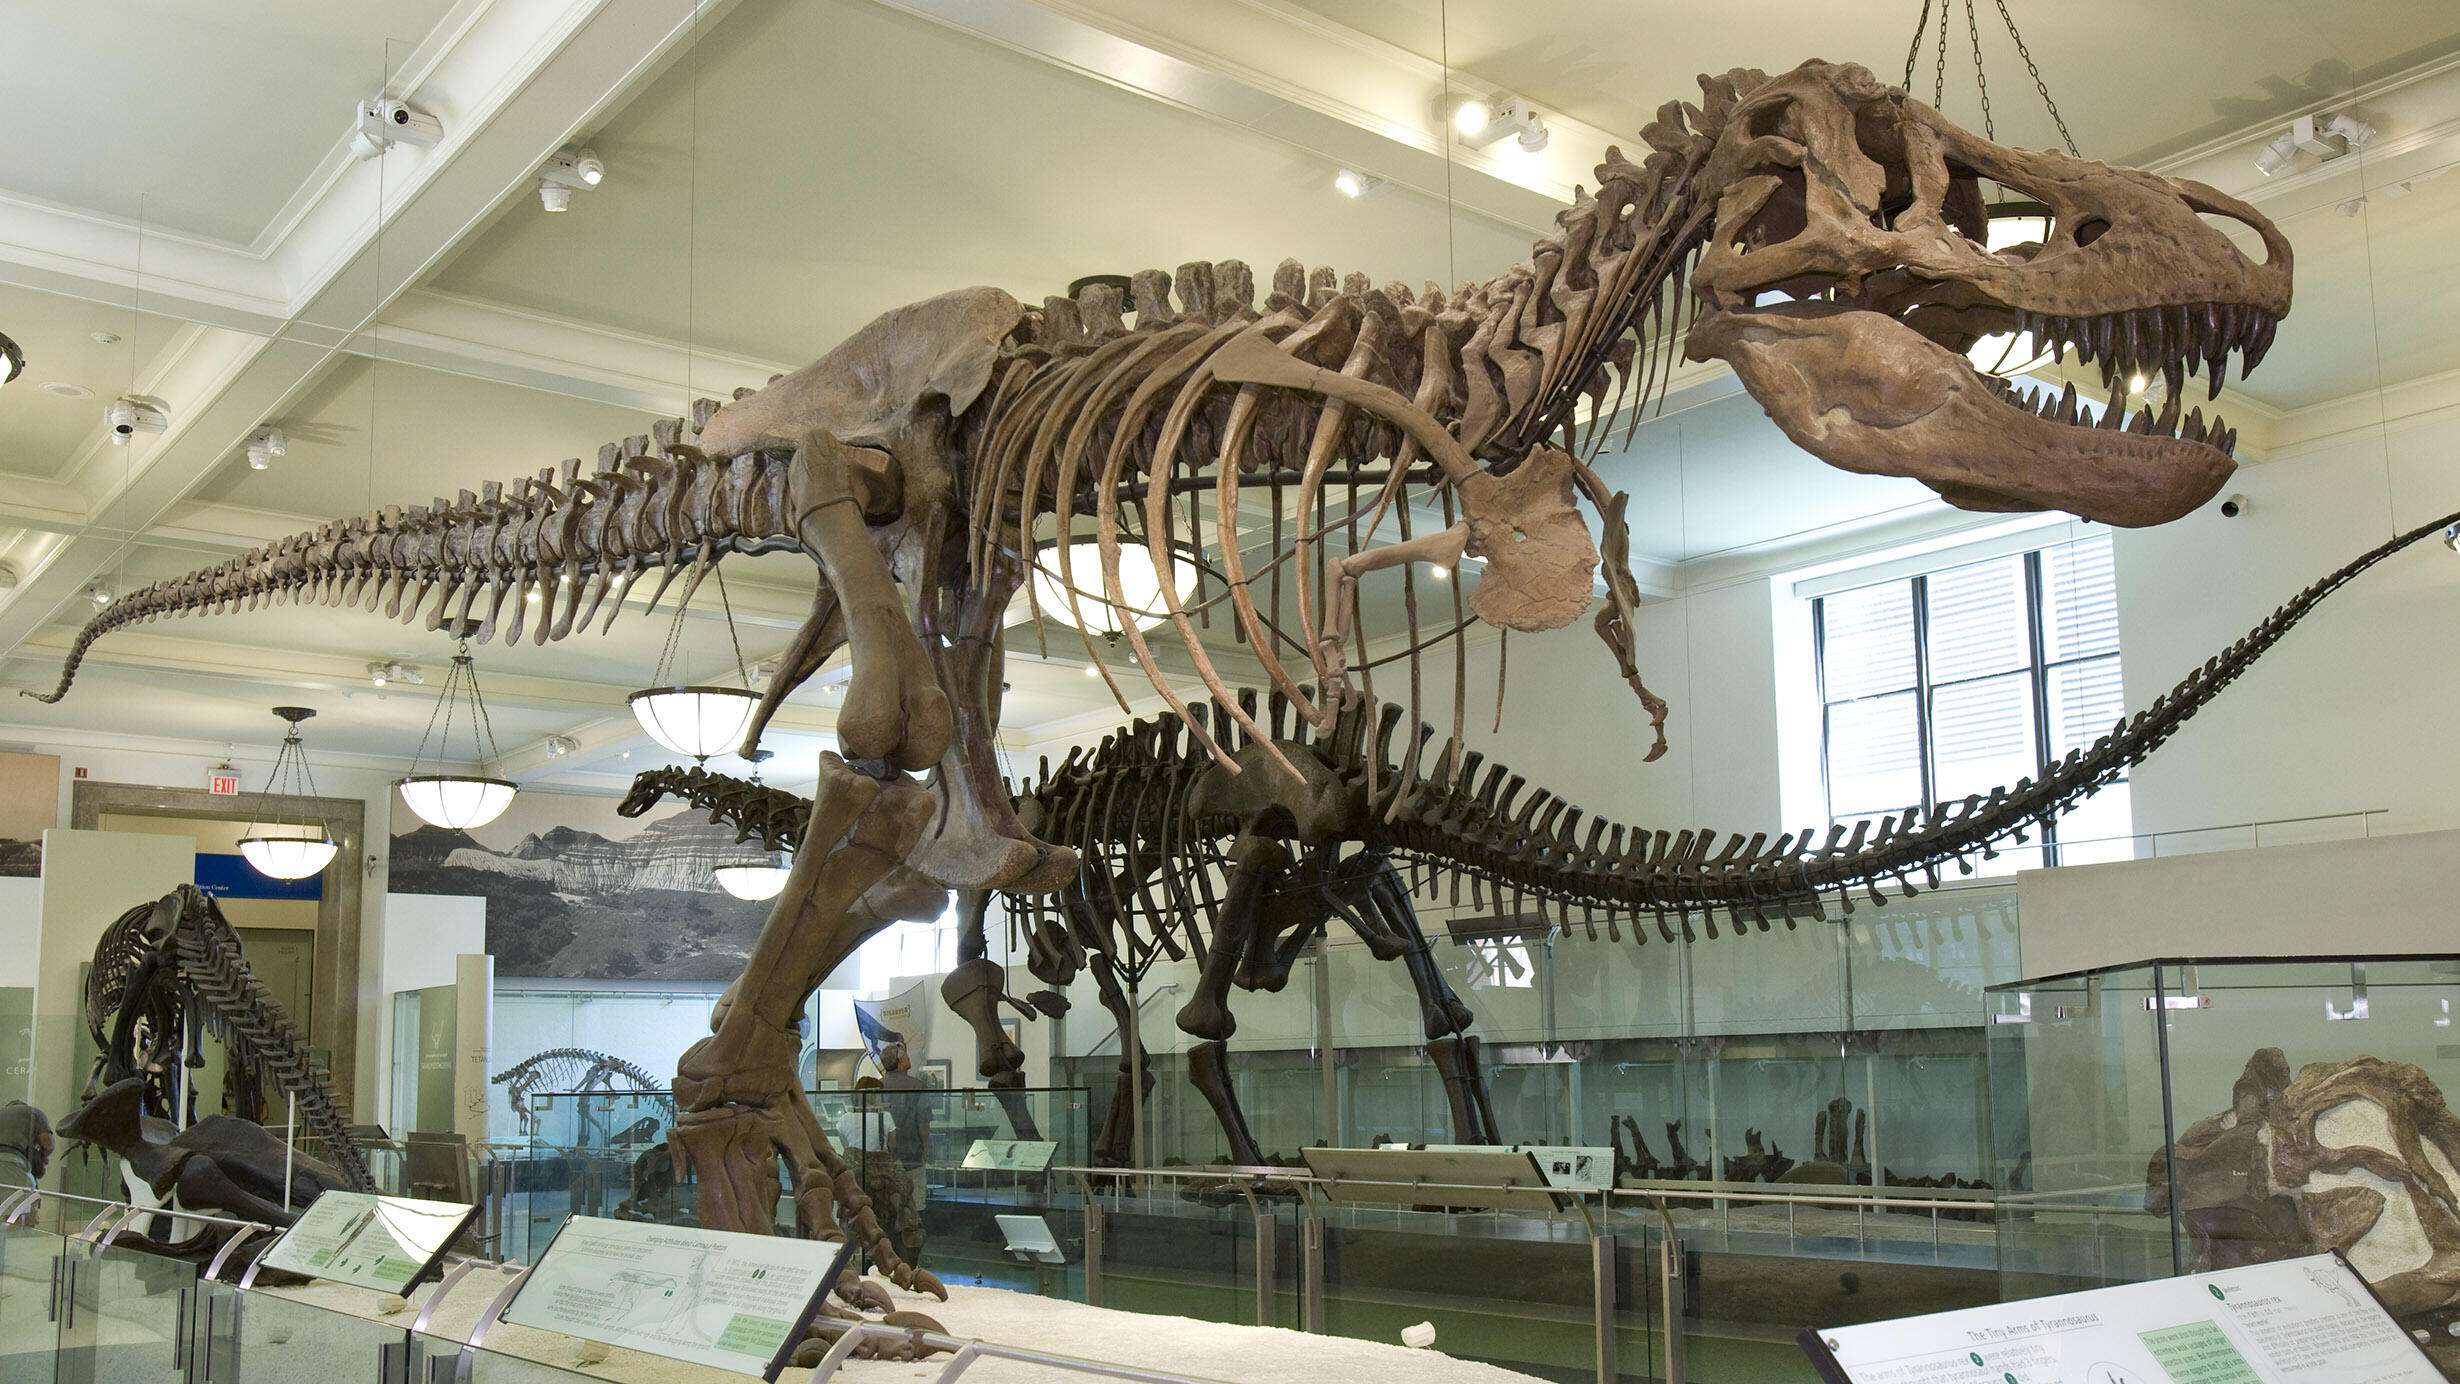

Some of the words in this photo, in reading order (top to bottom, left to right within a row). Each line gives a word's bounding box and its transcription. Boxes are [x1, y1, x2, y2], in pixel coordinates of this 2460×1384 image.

[213, 776, 237, 793] EXIT
[1967, 1330, 1986, 1341] The
[1985, 1327, 2006, 1339] Tiny
[2006, 1325, 2030, 1337] Arms
[2040, 1313, 2099, 1331] Tyrannosaurus
